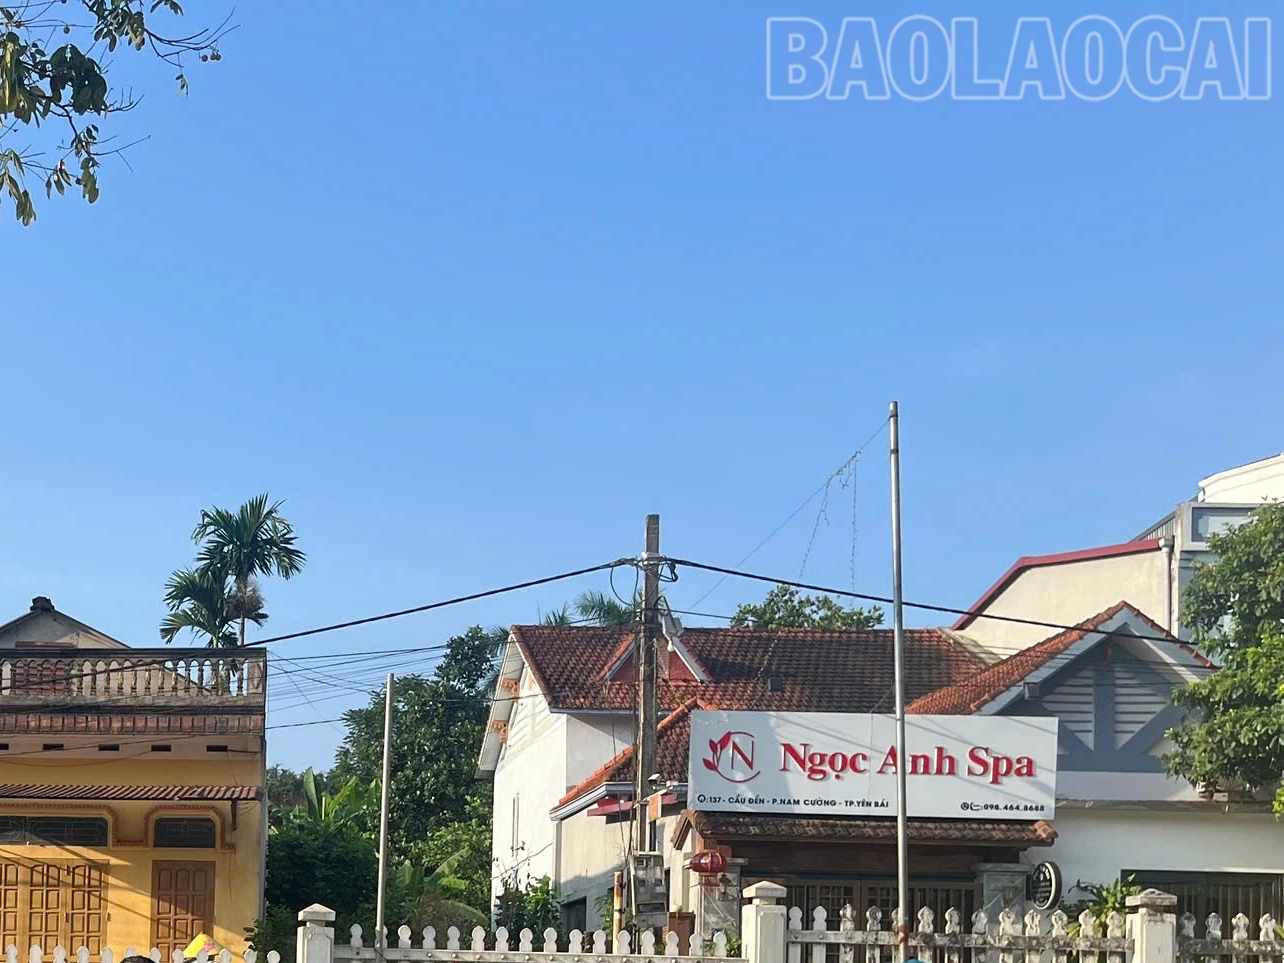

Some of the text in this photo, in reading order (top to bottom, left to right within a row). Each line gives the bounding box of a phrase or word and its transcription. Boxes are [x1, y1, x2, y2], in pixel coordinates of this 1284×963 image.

[779, 742, 1035, 785] Ngọc Anh Spa
[771, 798, 800, 806] P.NAM
[803, 796, 837, 807] CƯỜNG
[844, 798, 872, 808] TP.YÊN
[874, 798, 889, 808] BÁI
